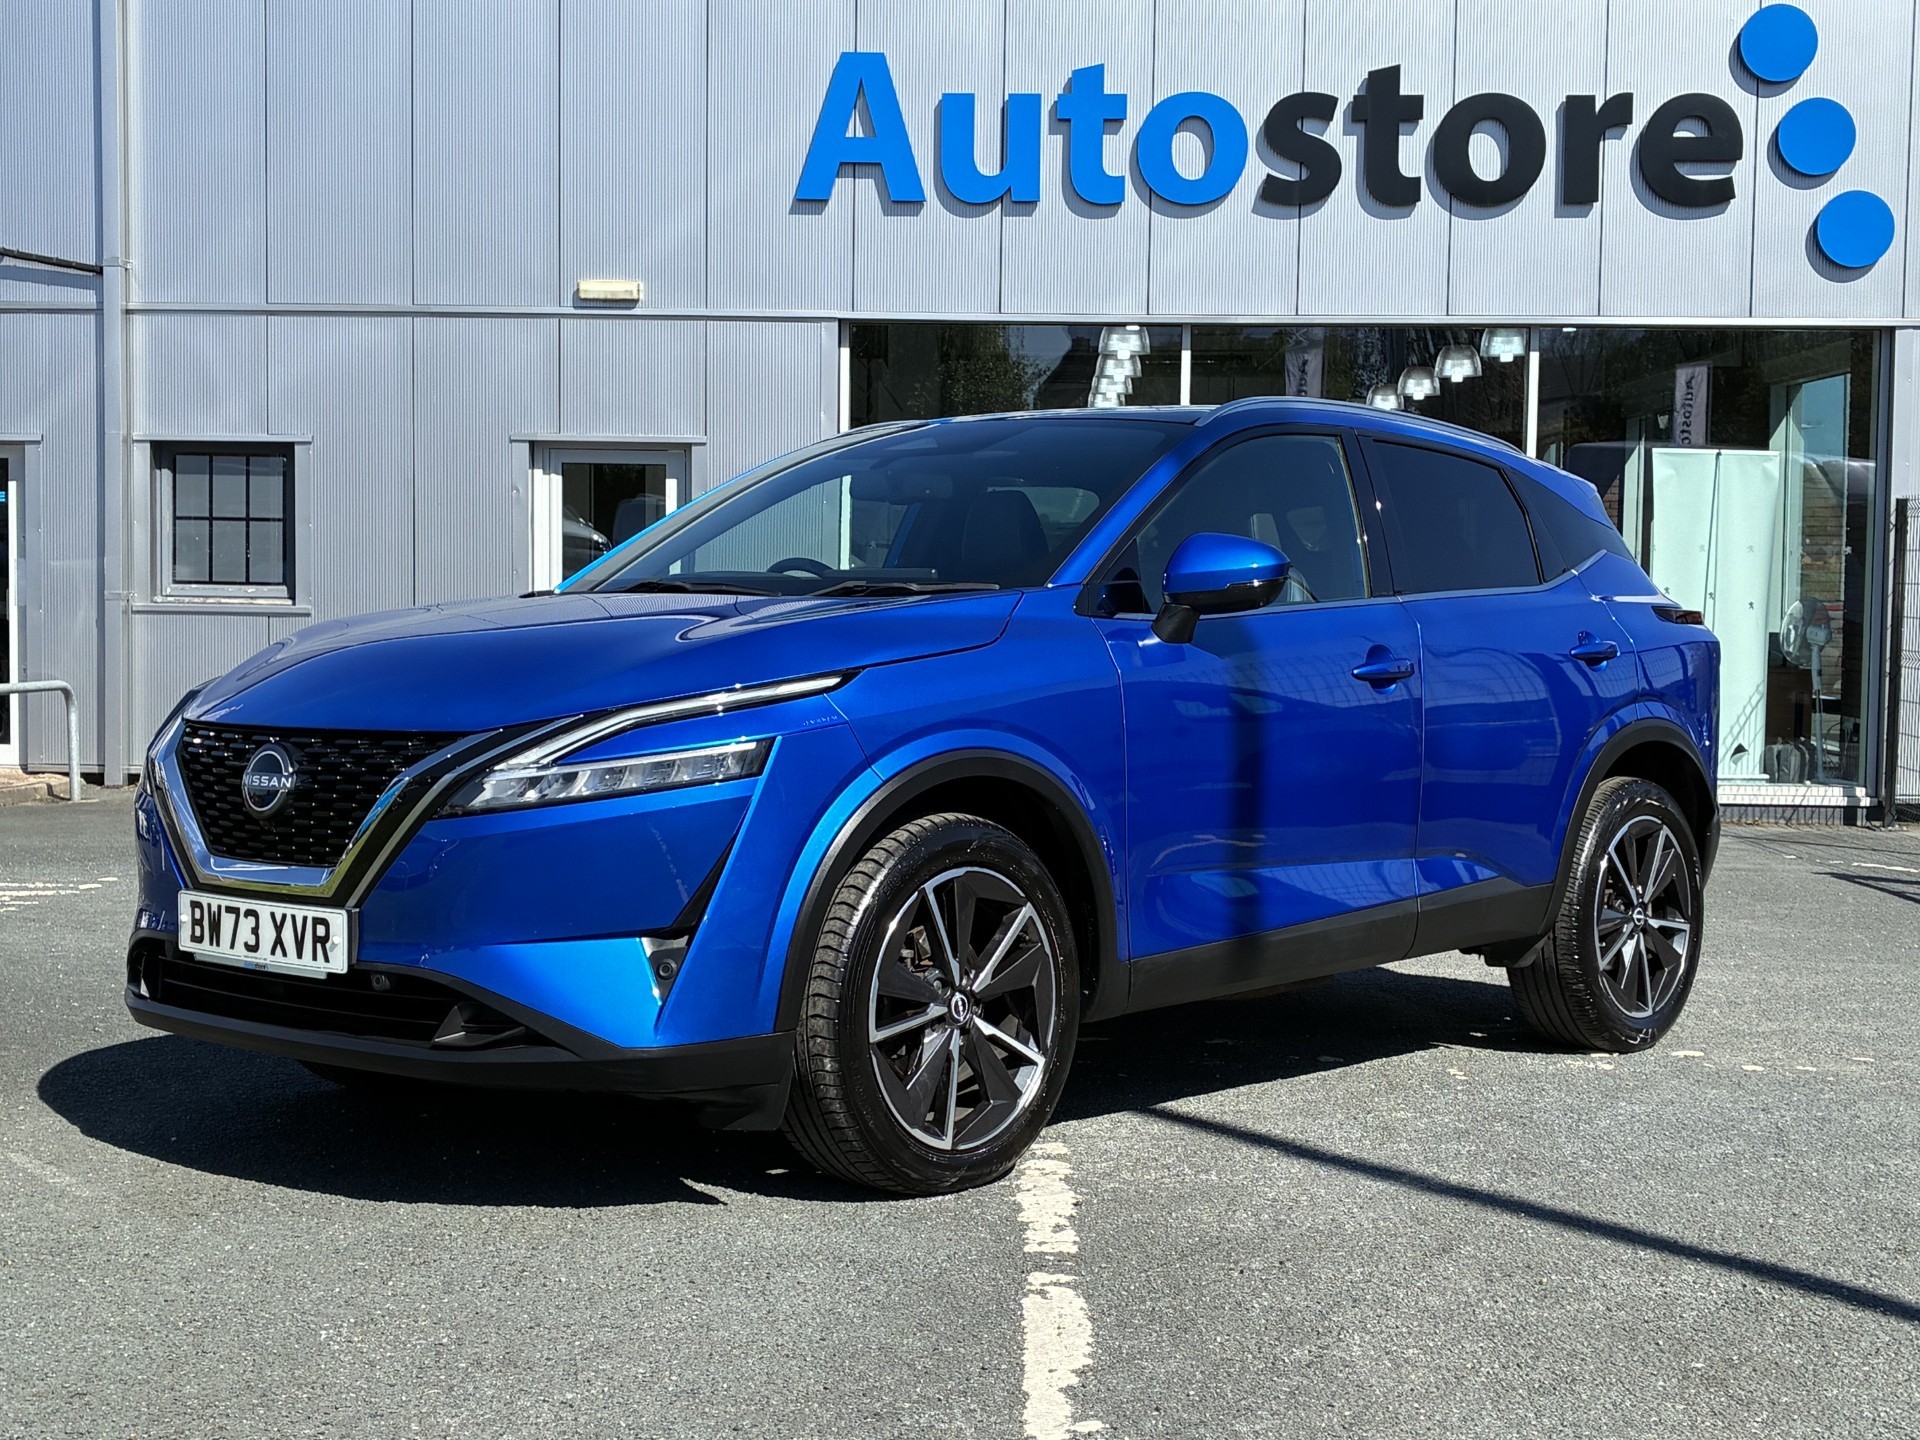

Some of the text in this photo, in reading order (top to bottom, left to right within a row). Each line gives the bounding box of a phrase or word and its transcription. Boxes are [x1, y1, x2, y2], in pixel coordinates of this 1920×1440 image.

[795, 51, 1744, 208] Autostore
[244, 774, 292, 788] NISSAN
[189, 899, 331, 964] BW73 XVR
